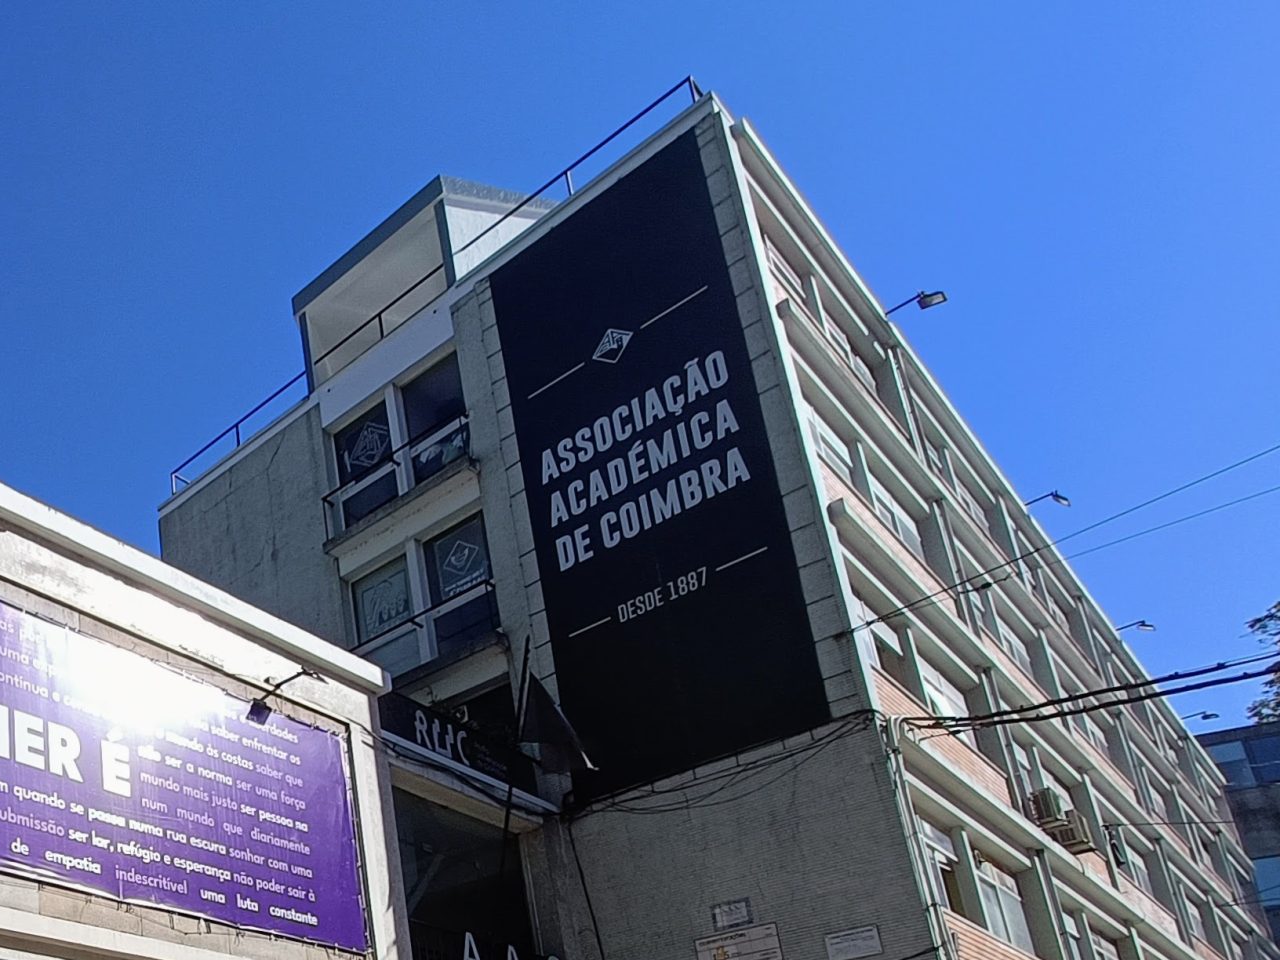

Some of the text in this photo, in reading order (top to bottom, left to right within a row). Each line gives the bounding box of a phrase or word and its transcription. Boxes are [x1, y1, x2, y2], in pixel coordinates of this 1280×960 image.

[542, 350, 729, 485] ASSOCIAÇÃO
[551, 398, 740, 528] ACADÉMICA
[555, 447, 751, 572] DE COIMBRA
[617, 566, 708, 623] DESDE 1887
[100, 724, 132, 798] É
[220, 751, 254, 771] costas
[255, 763, 284, 780] saber
[284, 774, 304, 788] que
[13, 785, 66, 810] quando
[128, 819, 164, 838] numa
[166, 829, 188, 844] rua
[189, 836, 227, 855] escura
[228, 847, 266, 865] sonhar
[267, 858, 289, 872] com
[290, 864, 313, 879] uma
[140, 772, 294, 828] mundo mais justo ser pessoa
[141, 797, 311, 856] num mundo que diariamente
[254, 785, 278, 801] uma
[280, 790, 307, 811] força
[44, 850, 102, 875] empatia
[115, 864, 188, 895] indescritível
[199, 888, 226, 904] uma
[236, 893, 259, 912] luta
[269, 906, 319, 926] constante
[68, 828, 90, 843] ser
[91, 829, 115, 853] lar,
[116, 840, 162, 864] refúgio
[173, 856, 232, 883] esperança
[233, 871, 254, 886] não
[255, 878, 286, 894] poder
[287, 885, 307, 900] sair
